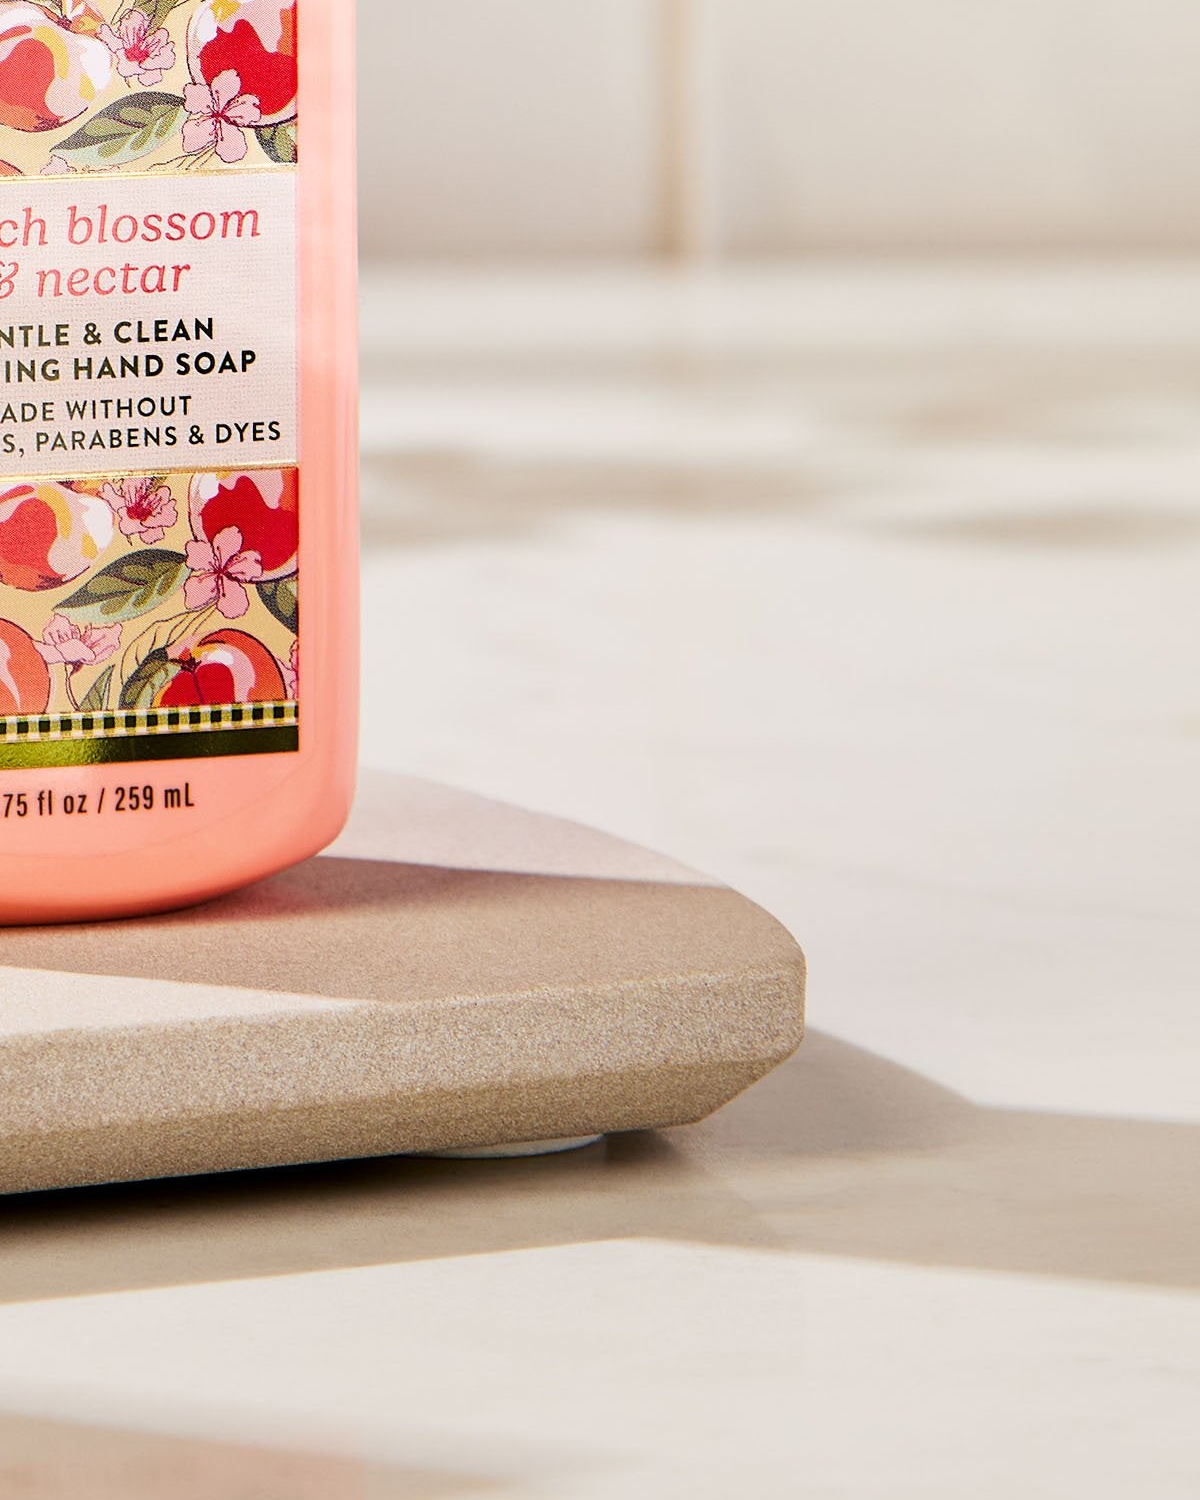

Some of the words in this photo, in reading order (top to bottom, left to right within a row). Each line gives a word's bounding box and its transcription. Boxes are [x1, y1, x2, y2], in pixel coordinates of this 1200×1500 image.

[67, 204, 261, 246] blossom
[36, 262, 192, 298] nectar
[83, 323, 102, 345] &
[113, 317, 214, 344] CLEAN
[73, 353, 164, 379] HAND
[176, 350, 257, 376] SOAP
[66, 395, 193, 421] WITHOUT
[36, 425, 177, 452] PARABENS
[188, 424, 204, 444] &
[216, 420, 281, 443] DYES
[38, 789, 53, 816] fl
[63, 792, 88, 815] oz
[97, 788, 106, 814] /
[115, 785, 154, 811] 259
[164, 782, 195, 808] mL
